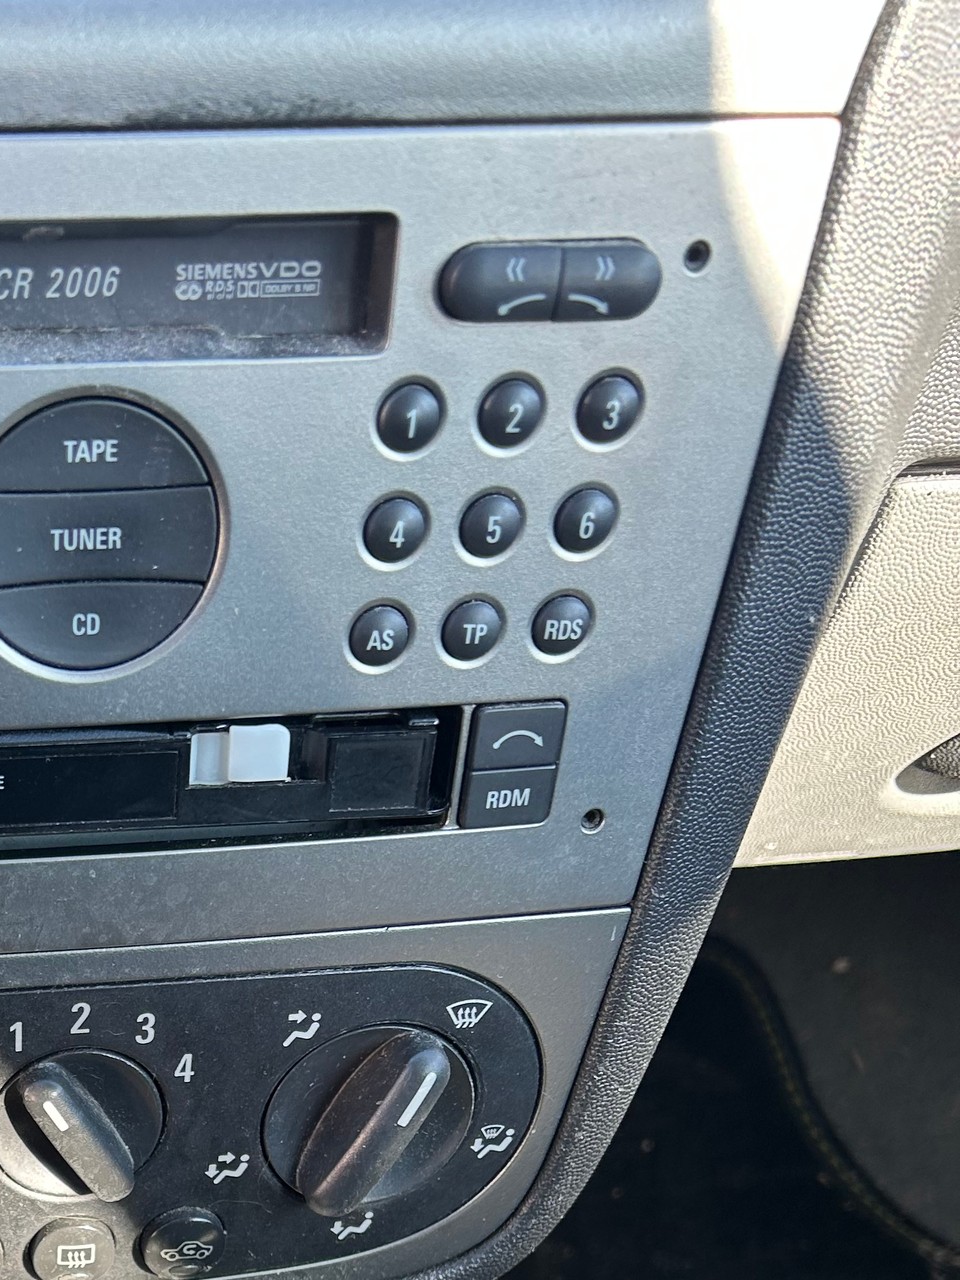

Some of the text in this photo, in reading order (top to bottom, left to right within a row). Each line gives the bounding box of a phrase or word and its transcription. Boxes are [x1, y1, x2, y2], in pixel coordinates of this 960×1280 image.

[45, 266, 121, 299] 2006
[405, 408, 418, 440] 1
[504, 402, 524, 434] 2
[602, 400, 620, 431] 3
[63, 439, 119, 463] TAPE
[50, 526, 122, 551] TUNER
[388, 520, 405, 549] 4
[485, 515, 502, 544] 5
[578, 511, 596, 540] 6
[71, 612, 101, 637] CD
[463, 623, 489, 646] TP
[543, 617, 583, 642] RDS
[366, 630, 395, 652] AS
[485, 787, 531, 810] RDM
[9, 1002, 195, 1083] 1 2 3 4
